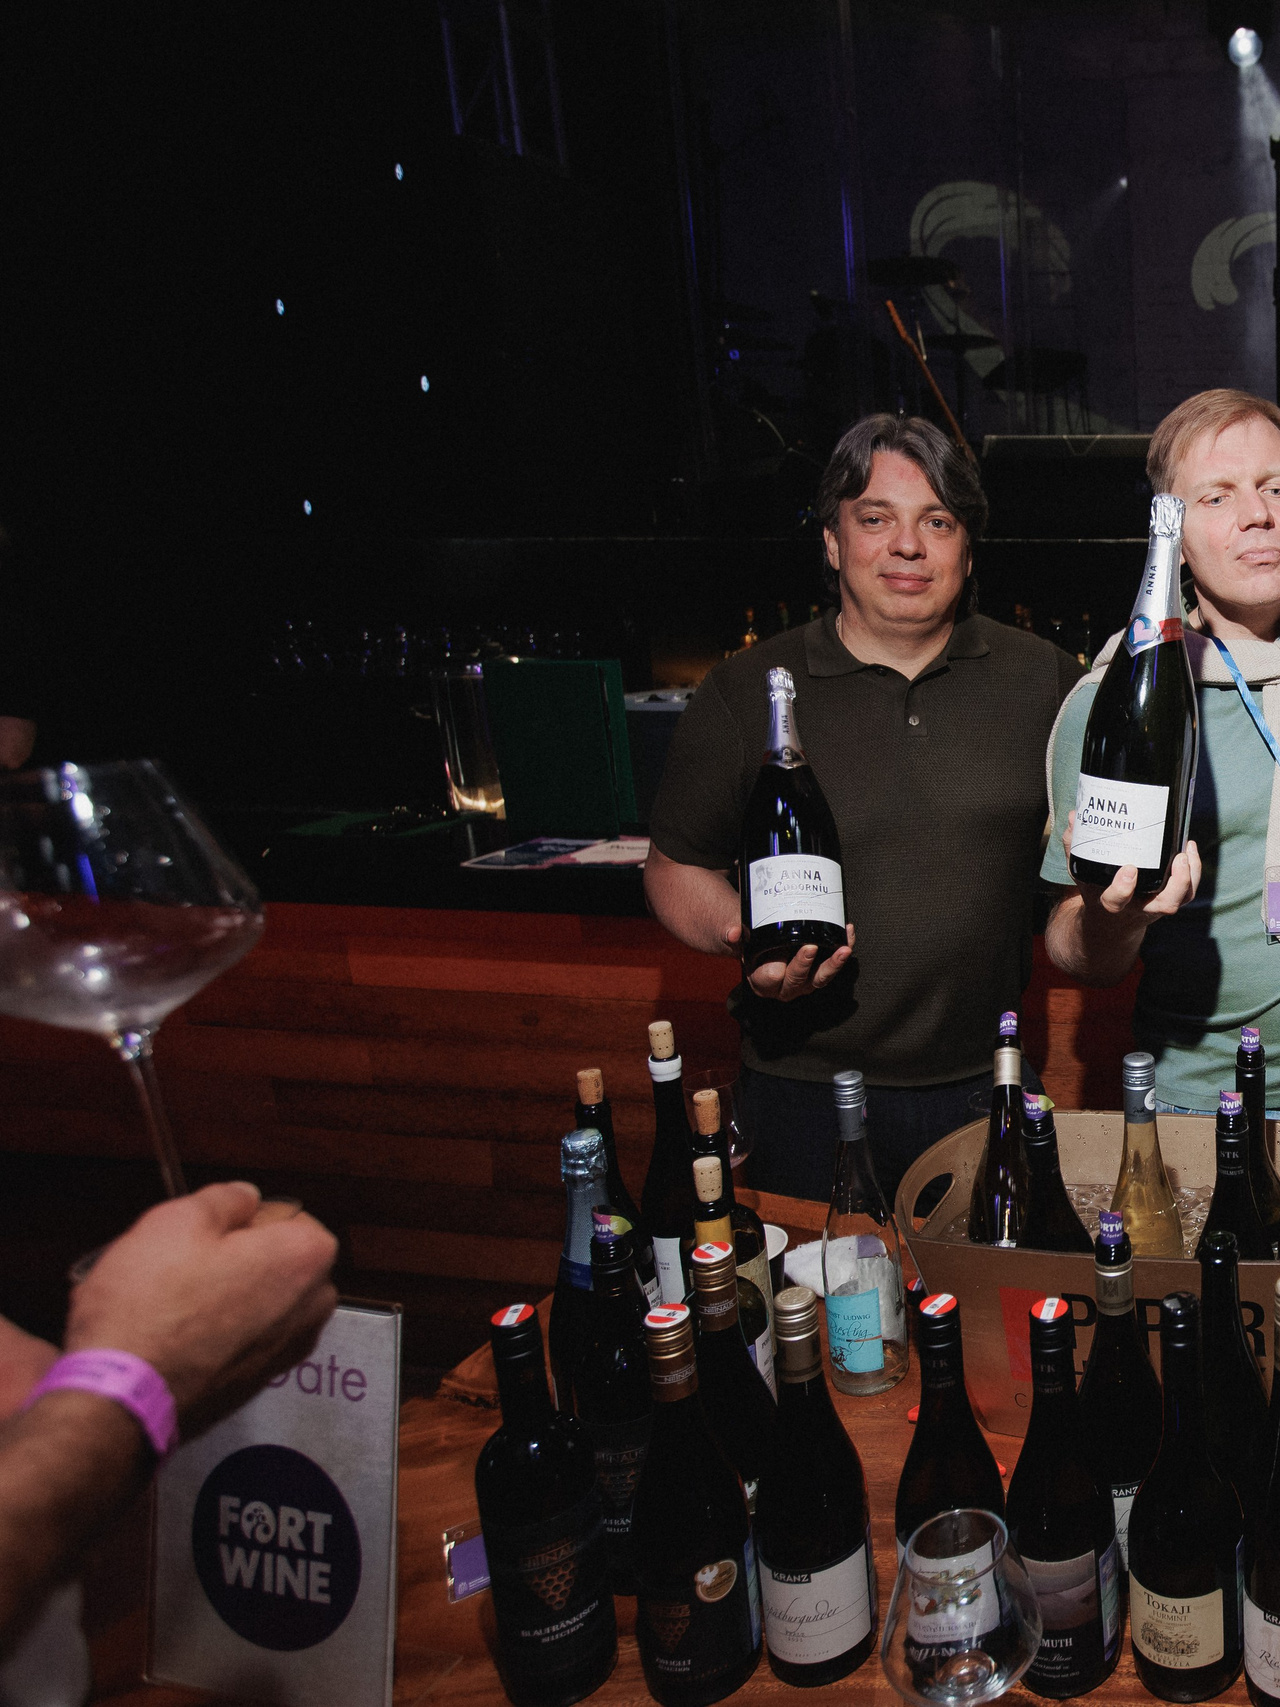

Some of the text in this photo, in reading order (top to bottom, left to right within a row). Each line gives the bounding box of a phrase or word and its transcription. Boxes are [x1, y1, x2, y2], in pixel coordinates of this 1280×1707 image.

[1145, 564, 1158, 596] ANNA
[1087, 796, 1129, 816] ANNA
[1091, 847, 1111, 857] BRUT
[780, 869, 822, 881] ANNA
[763, 888, 774, 896] DE
[1220, 1151, 1240, 1159] STK
[843, 1313, 871, 1321] LUDWIG
[1112, 1486, 1139, 1498] RANZ
[218, 1494, 334, 1555] FORT
[219, 1542, 333, 1605] WINE
[772, 1571, 811, 1584] KRANZ
[1152, 1610, 1188, 1622] FURMENT
[1039, 1637, 1073, 1649] MUTH
